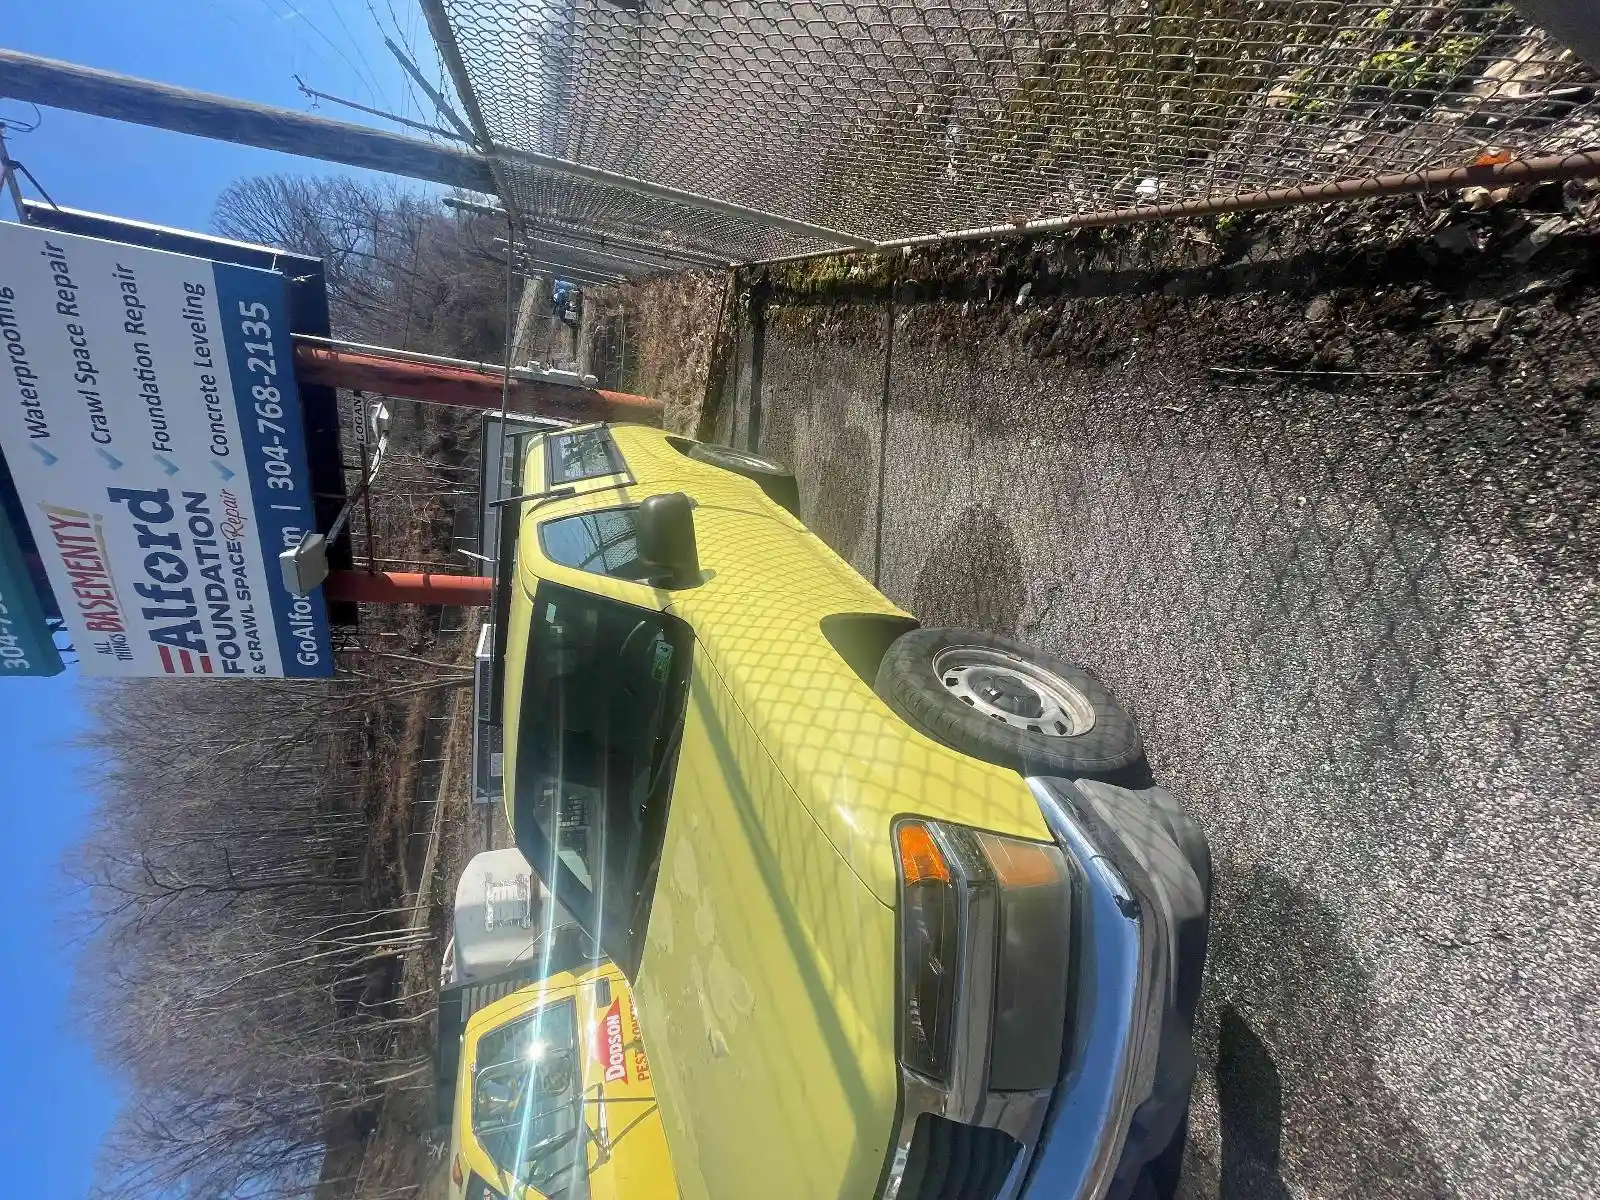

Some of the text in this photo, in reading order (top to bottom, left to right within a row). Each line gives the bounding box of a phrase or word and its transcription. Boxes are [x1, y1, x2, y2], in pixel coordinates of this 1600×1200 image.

[41, 240, 112, 445] Crawl Space Repair
[112, 262, 173, 453] Foundation Repair
[182, 281, 230, 457] Concrete Leveling
[238, 301, 294, 491] 304-768-2135
[353, 398, 365, 442] LOGAN
[93, 641, 110, 655] ALL
[106, 486, 209, 654] Alford
[108, 633, 134, 661] THINGS
[182, 490, 246, 674] FOUNDATION
[219, 488, 267, 675] & CRAWL SPACE Repair
[634, 1050, 650, 1081] PEST
